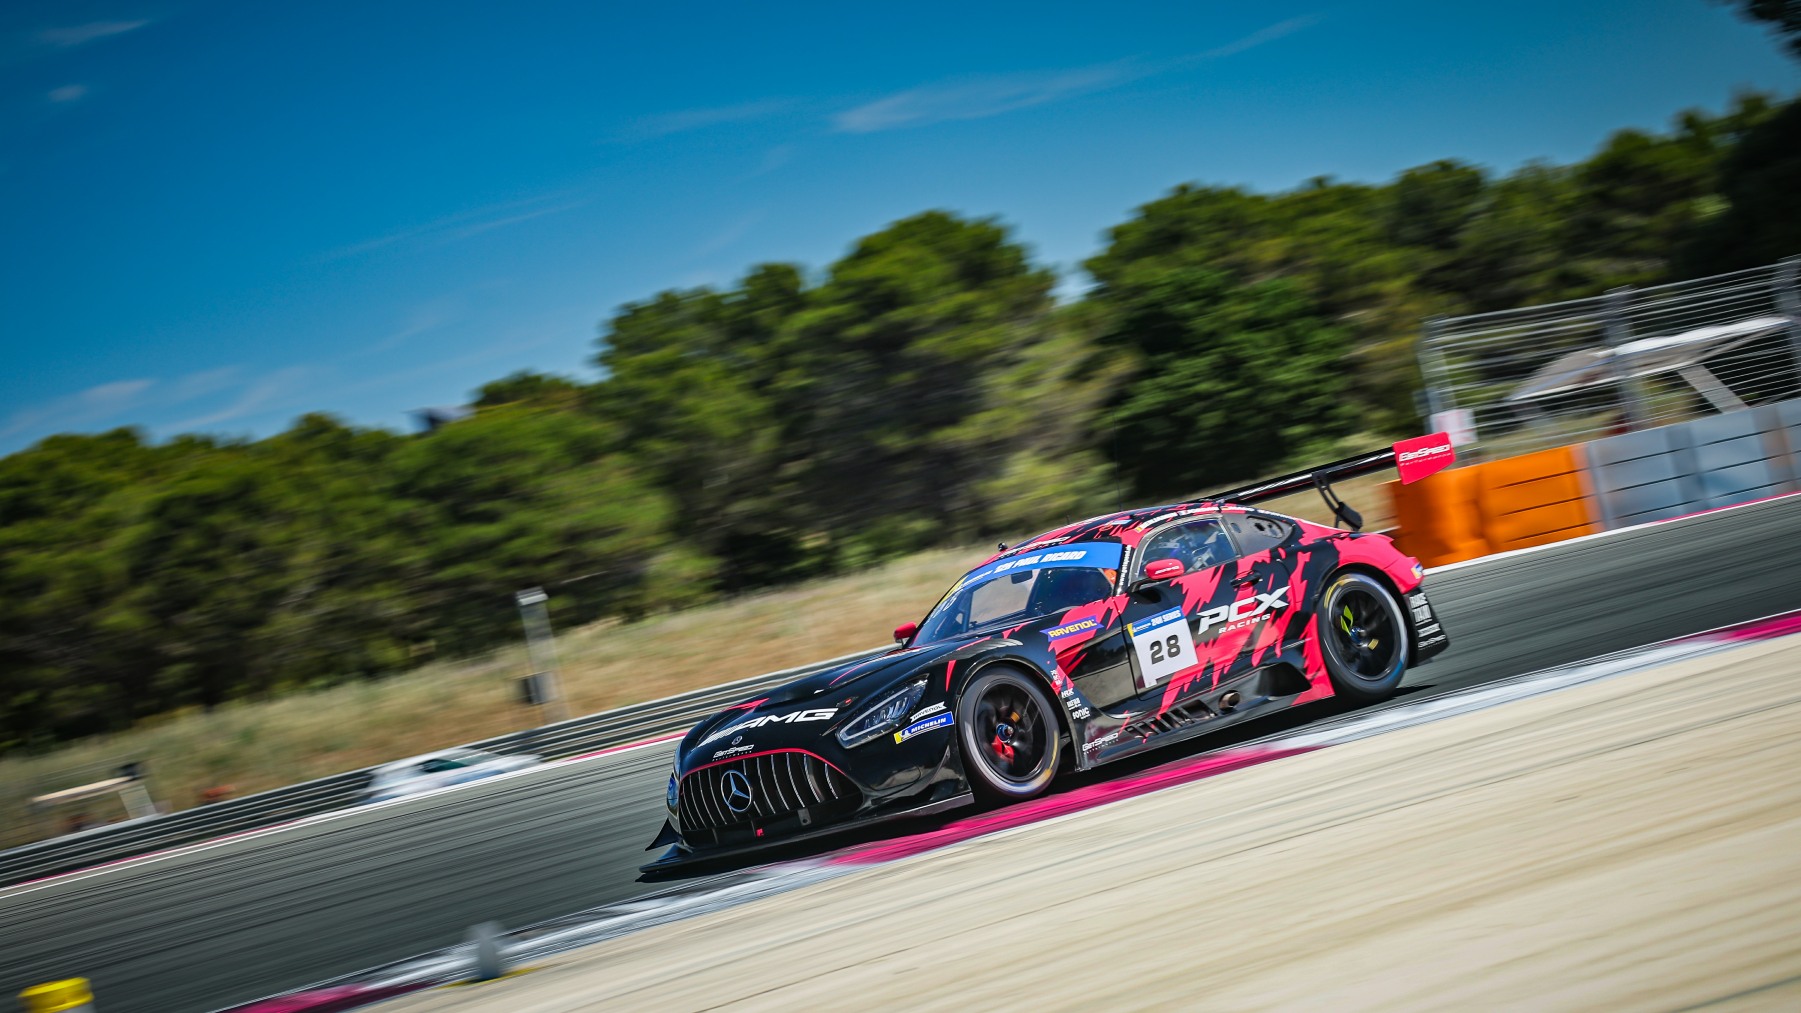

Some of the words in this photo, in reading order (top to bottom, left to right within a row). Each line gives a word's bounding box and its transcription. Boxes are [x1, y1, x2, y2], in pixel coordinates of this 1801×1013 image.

[1012, 555, 1042, 568] PAUL
[1040, 550, 1087, 563] RICARD
[1196, 585, 1291, 635] PCX
[1048, 619, 1098, 638] RAVENOL
[1218, 613, 1271, 634] RACING
[1150, 634, 1181, 665] 28
[742, 707, 839, 730] AMG
[911, 717, 947, 733] MICHELIN
